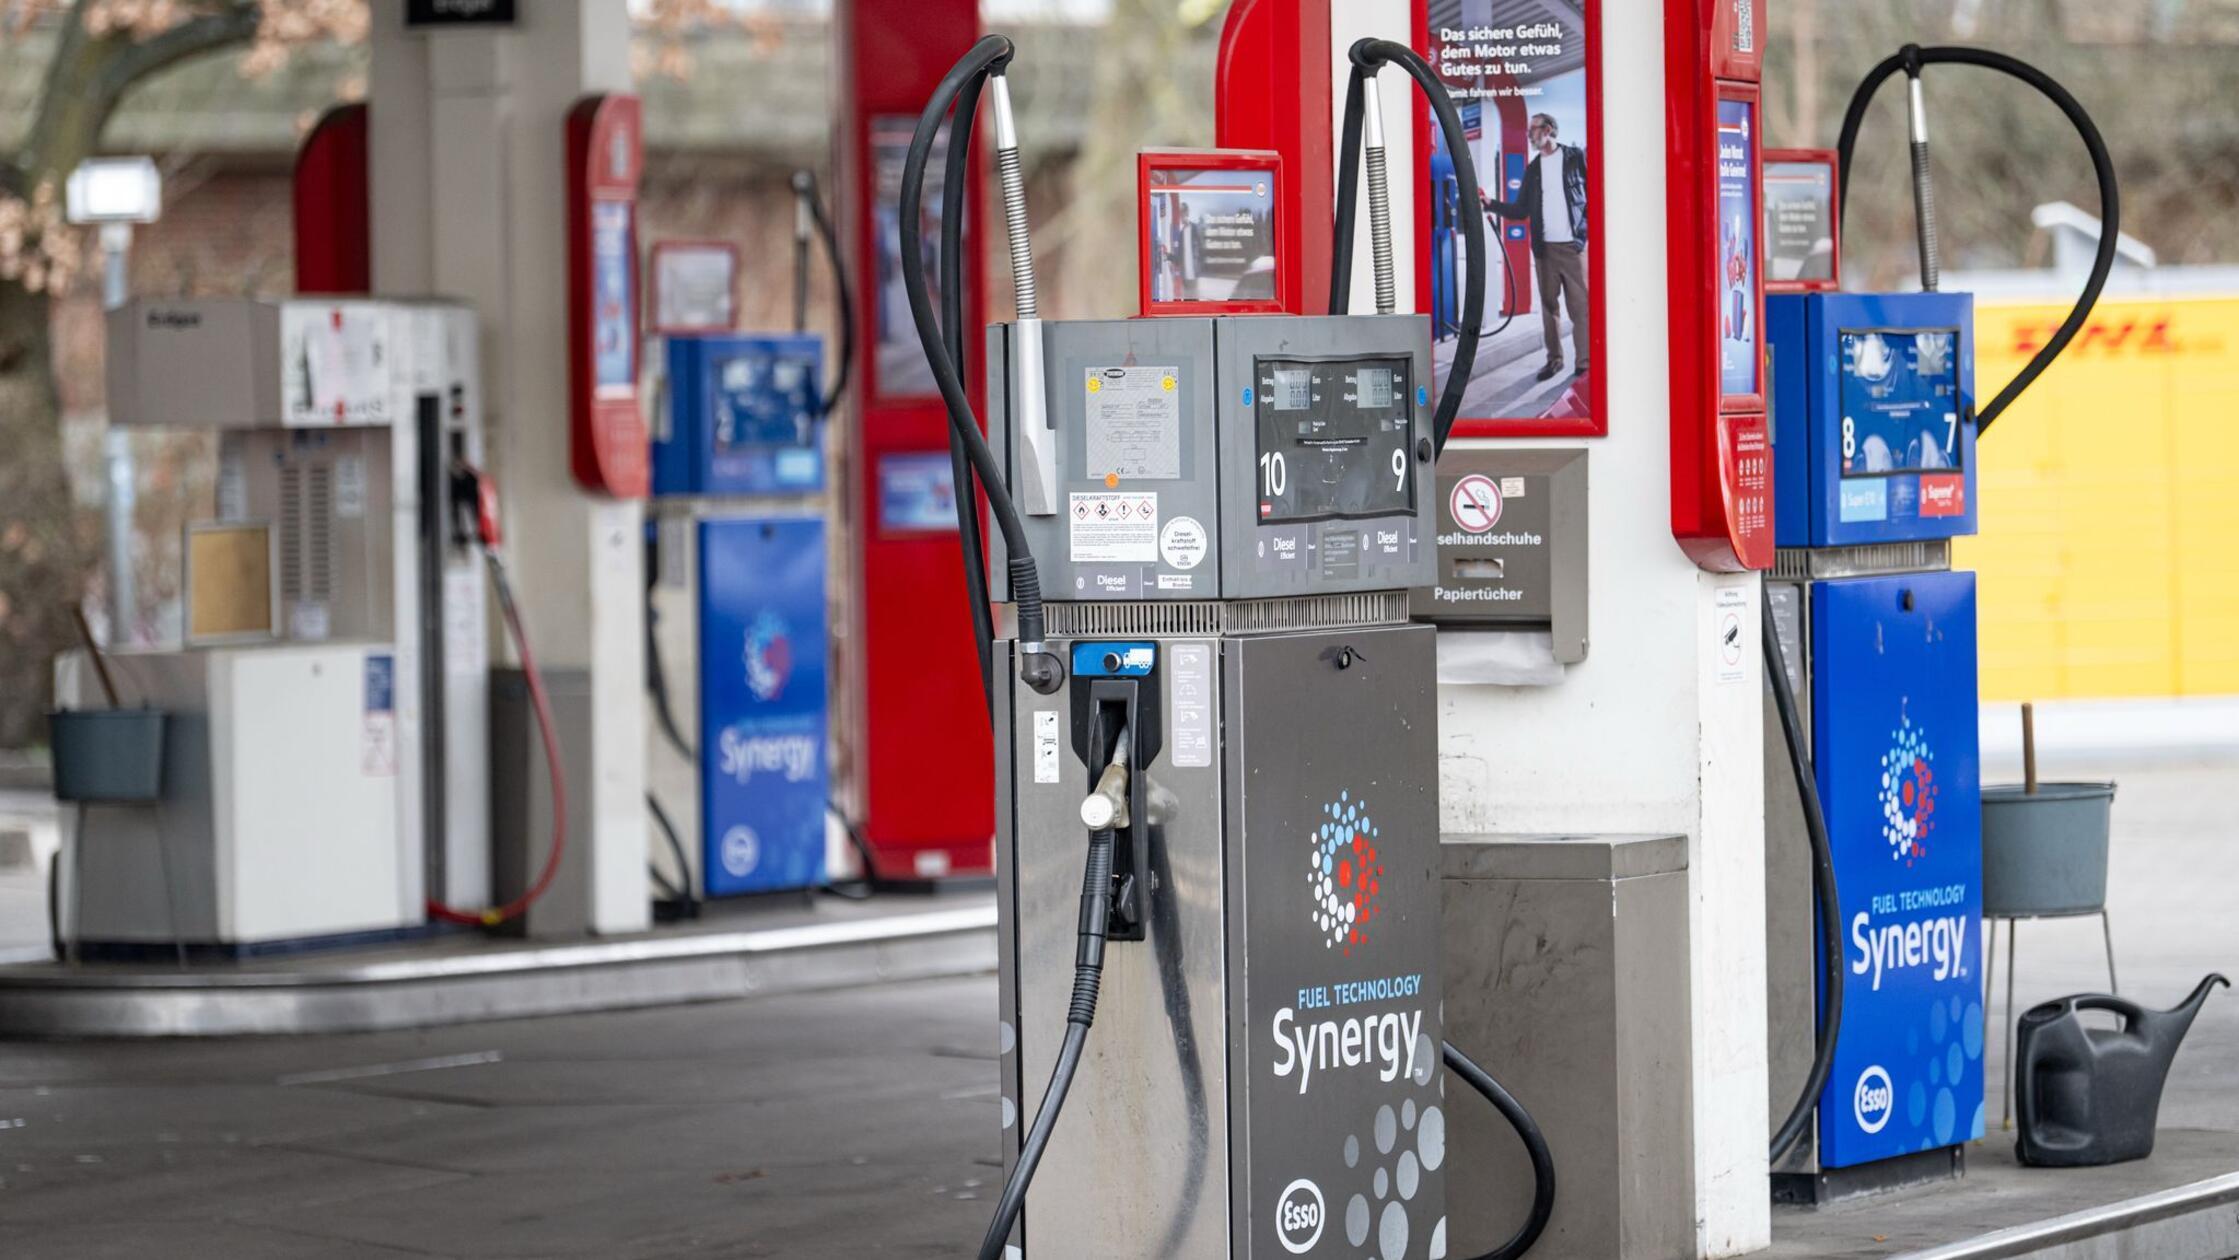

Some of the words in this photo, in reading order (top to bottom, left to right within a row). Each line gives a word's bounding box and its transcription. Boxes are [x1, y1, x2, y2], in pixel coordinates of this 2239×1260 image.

[1440, 28, 1465, 42] Das
[1468, 26, 1514, 41] sichere
[1516, 23, 1563, 39] Gefühl,
[1441, 46, 1471, 59] dem
[1474, 44, 1518, 58] Motor
[1520, 43, 1561, 56] etwas
[1441, 62, 1482, 76] Gutes
[1485, 64, 1501, 75] zu
[1505, 62, 1532, 74] tun.
[1448, 88, 1469, 99] amit
[1470, 87, 1497, 98] fahren
[1499, 87, 1513, 97] wir
[1514, 86, 1544, 97] besser.
[1842, 416, 1855, 458] 8
[1944, 413, 1957, 453] 7
[1260, 451, 1286, 496] 10
[1391, 448, 1406, 492] 9
[1273, 536, 1296, 551] Diesel
[1378, 530, 1398, 545] Diesel
[1437, 532, 1542, 545] selhandschuhe
[1097, 575, 1126, 586] Diesel
[1434, 587, 1523, 603] Papiertücher
[719, 725, 818, 785] Synergy
[1872, 895, 1897, 915] FUEL
[1899, 884, 1966, 911] TECHNOLOGY
[1852, 911, 1966, 991] Synergy
[1298, 988, 1330, 1010] FUEL
[1334, 974, 1421, 1006] TECHNOLOGY
[1272, 1007, 1422, 1095] Synergy
[1861, 1085, 1888, 1113] Esso
[1284, 1200, 1318, 1231] Esso
